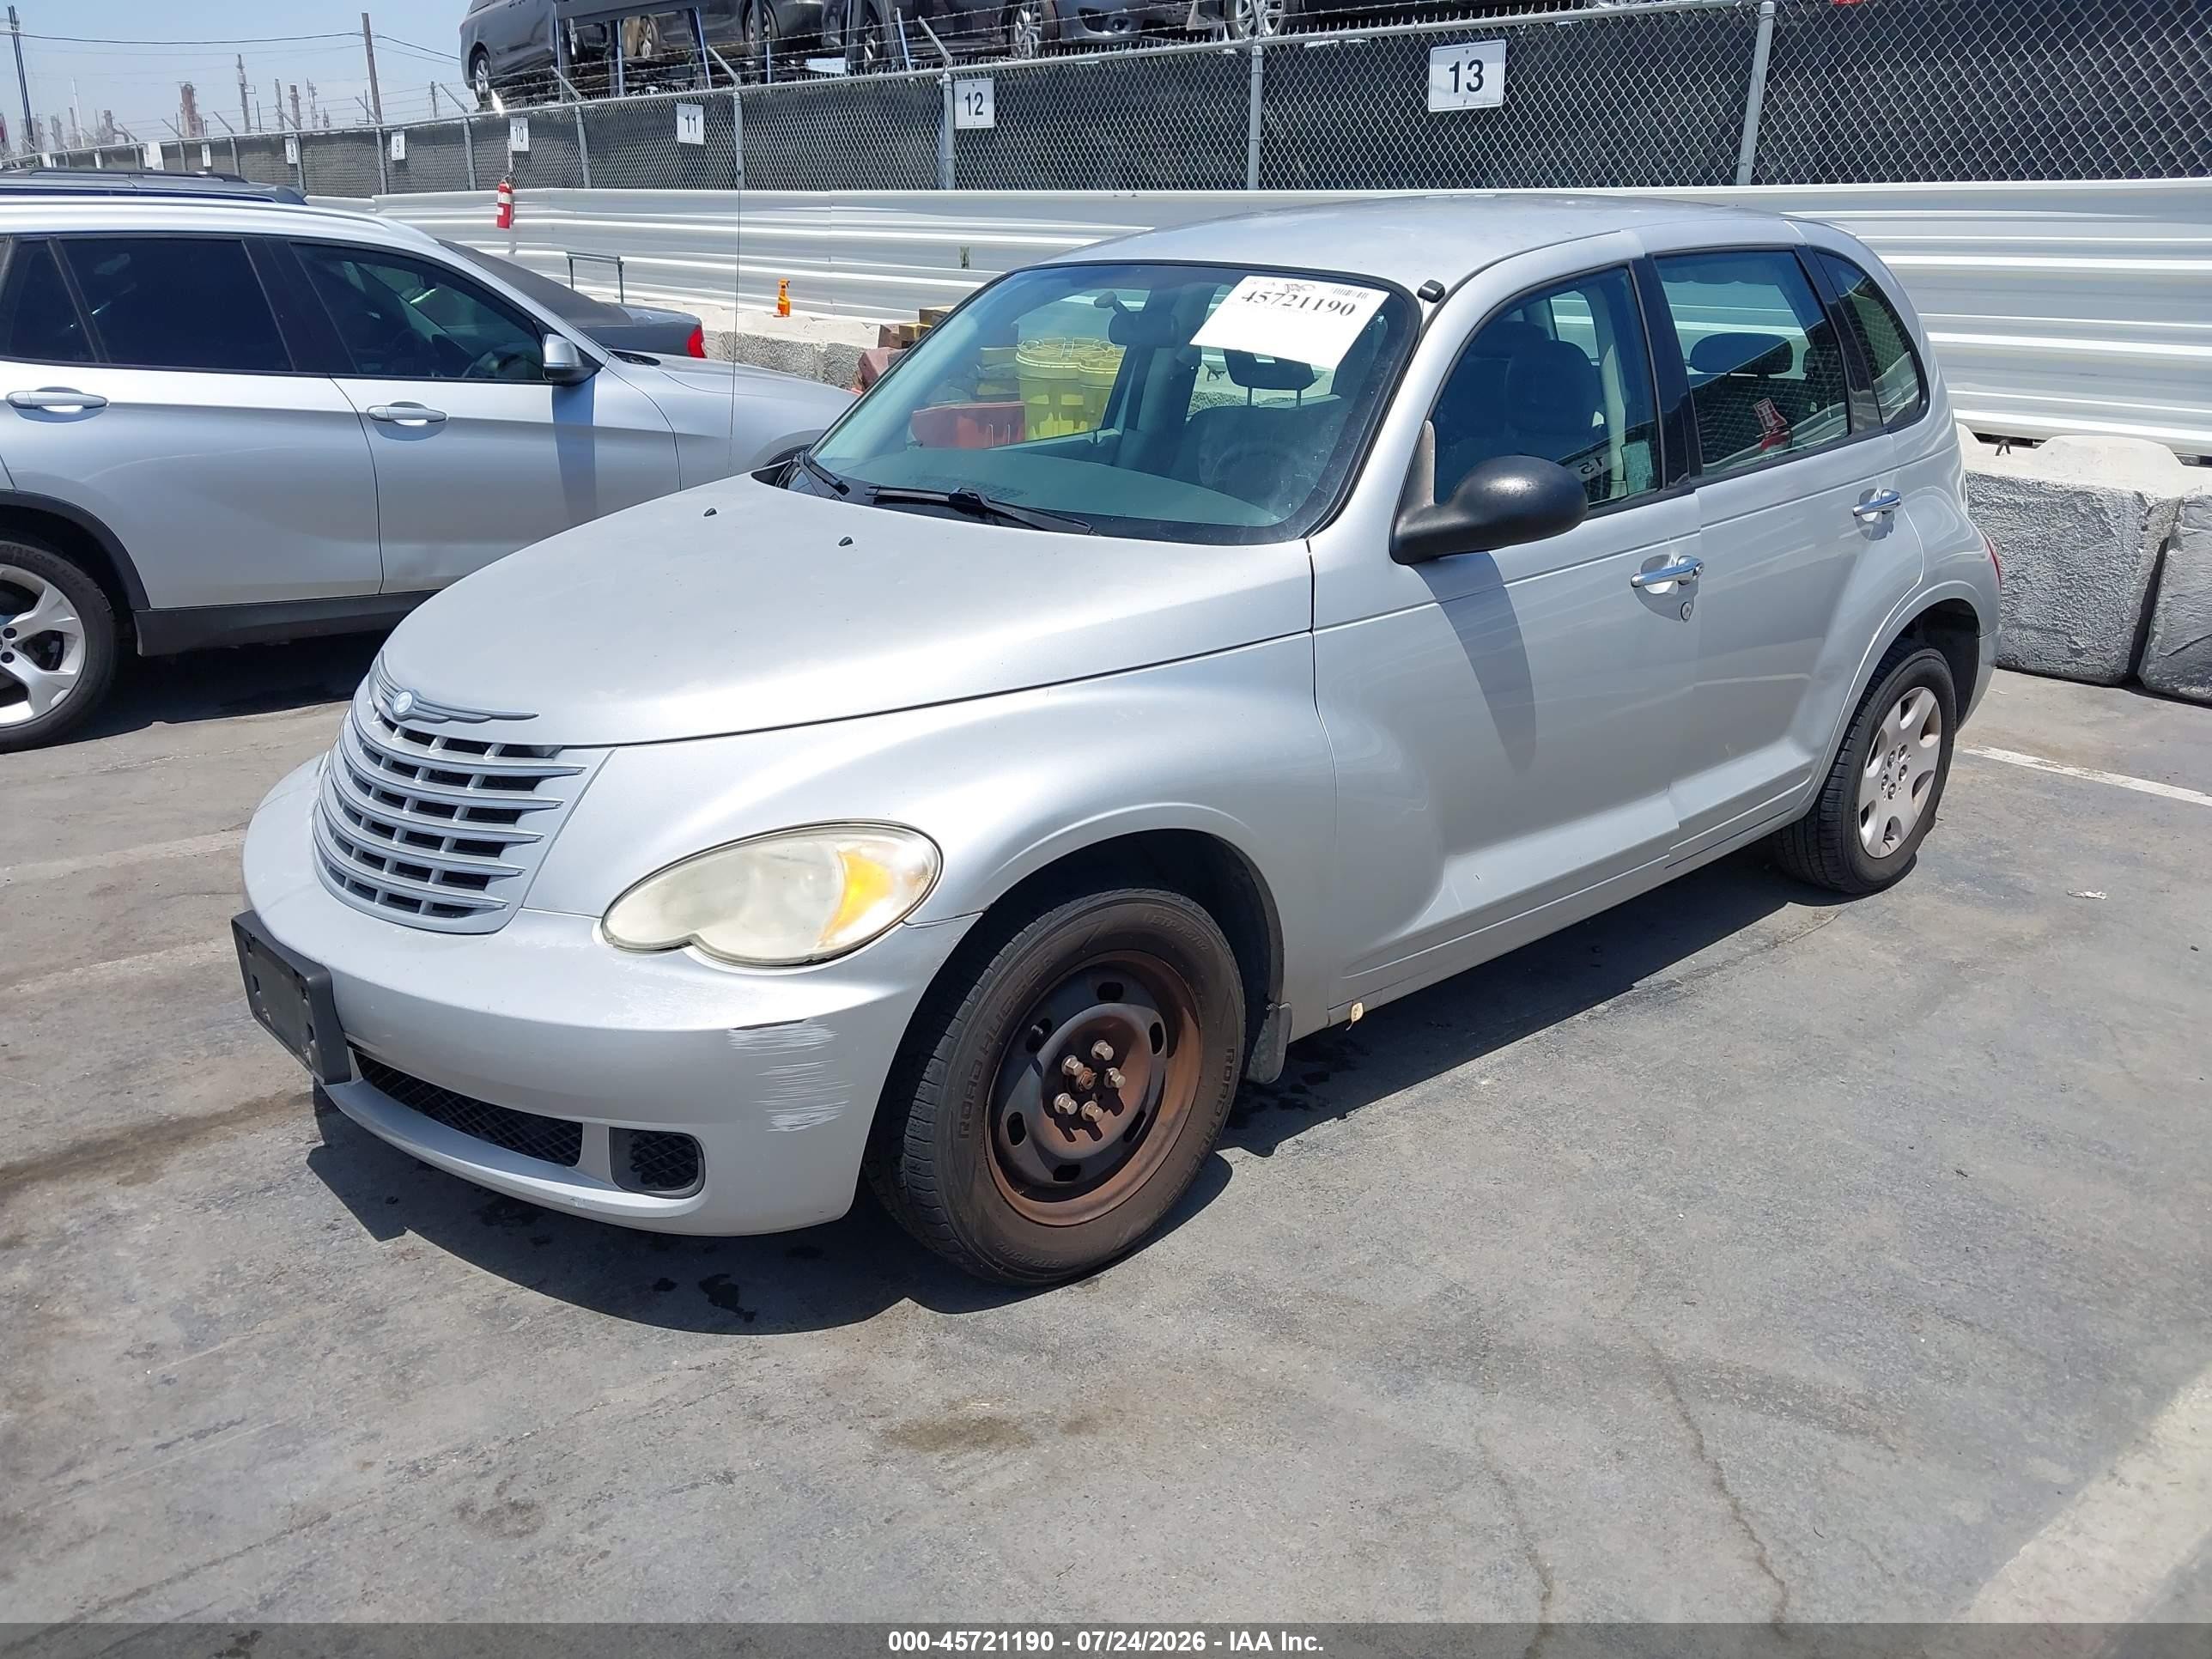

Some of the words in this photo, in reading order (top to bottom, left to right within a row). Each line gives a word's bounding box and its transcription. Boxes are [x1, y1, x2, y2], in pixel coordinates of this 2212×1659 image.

[1449, 58, 1484, 94] 13
[965, 91, 984, 116] 12
[514, 125, 524, 143] 10
[684, 114, 696, 135] 11
[396, 137, 400, 153] 9
[1241, 289, 1357, 317] 45721190
[1214, 1048, 1235, 1116] ROAD
[957, 1059, 983, 1139] ROAD
